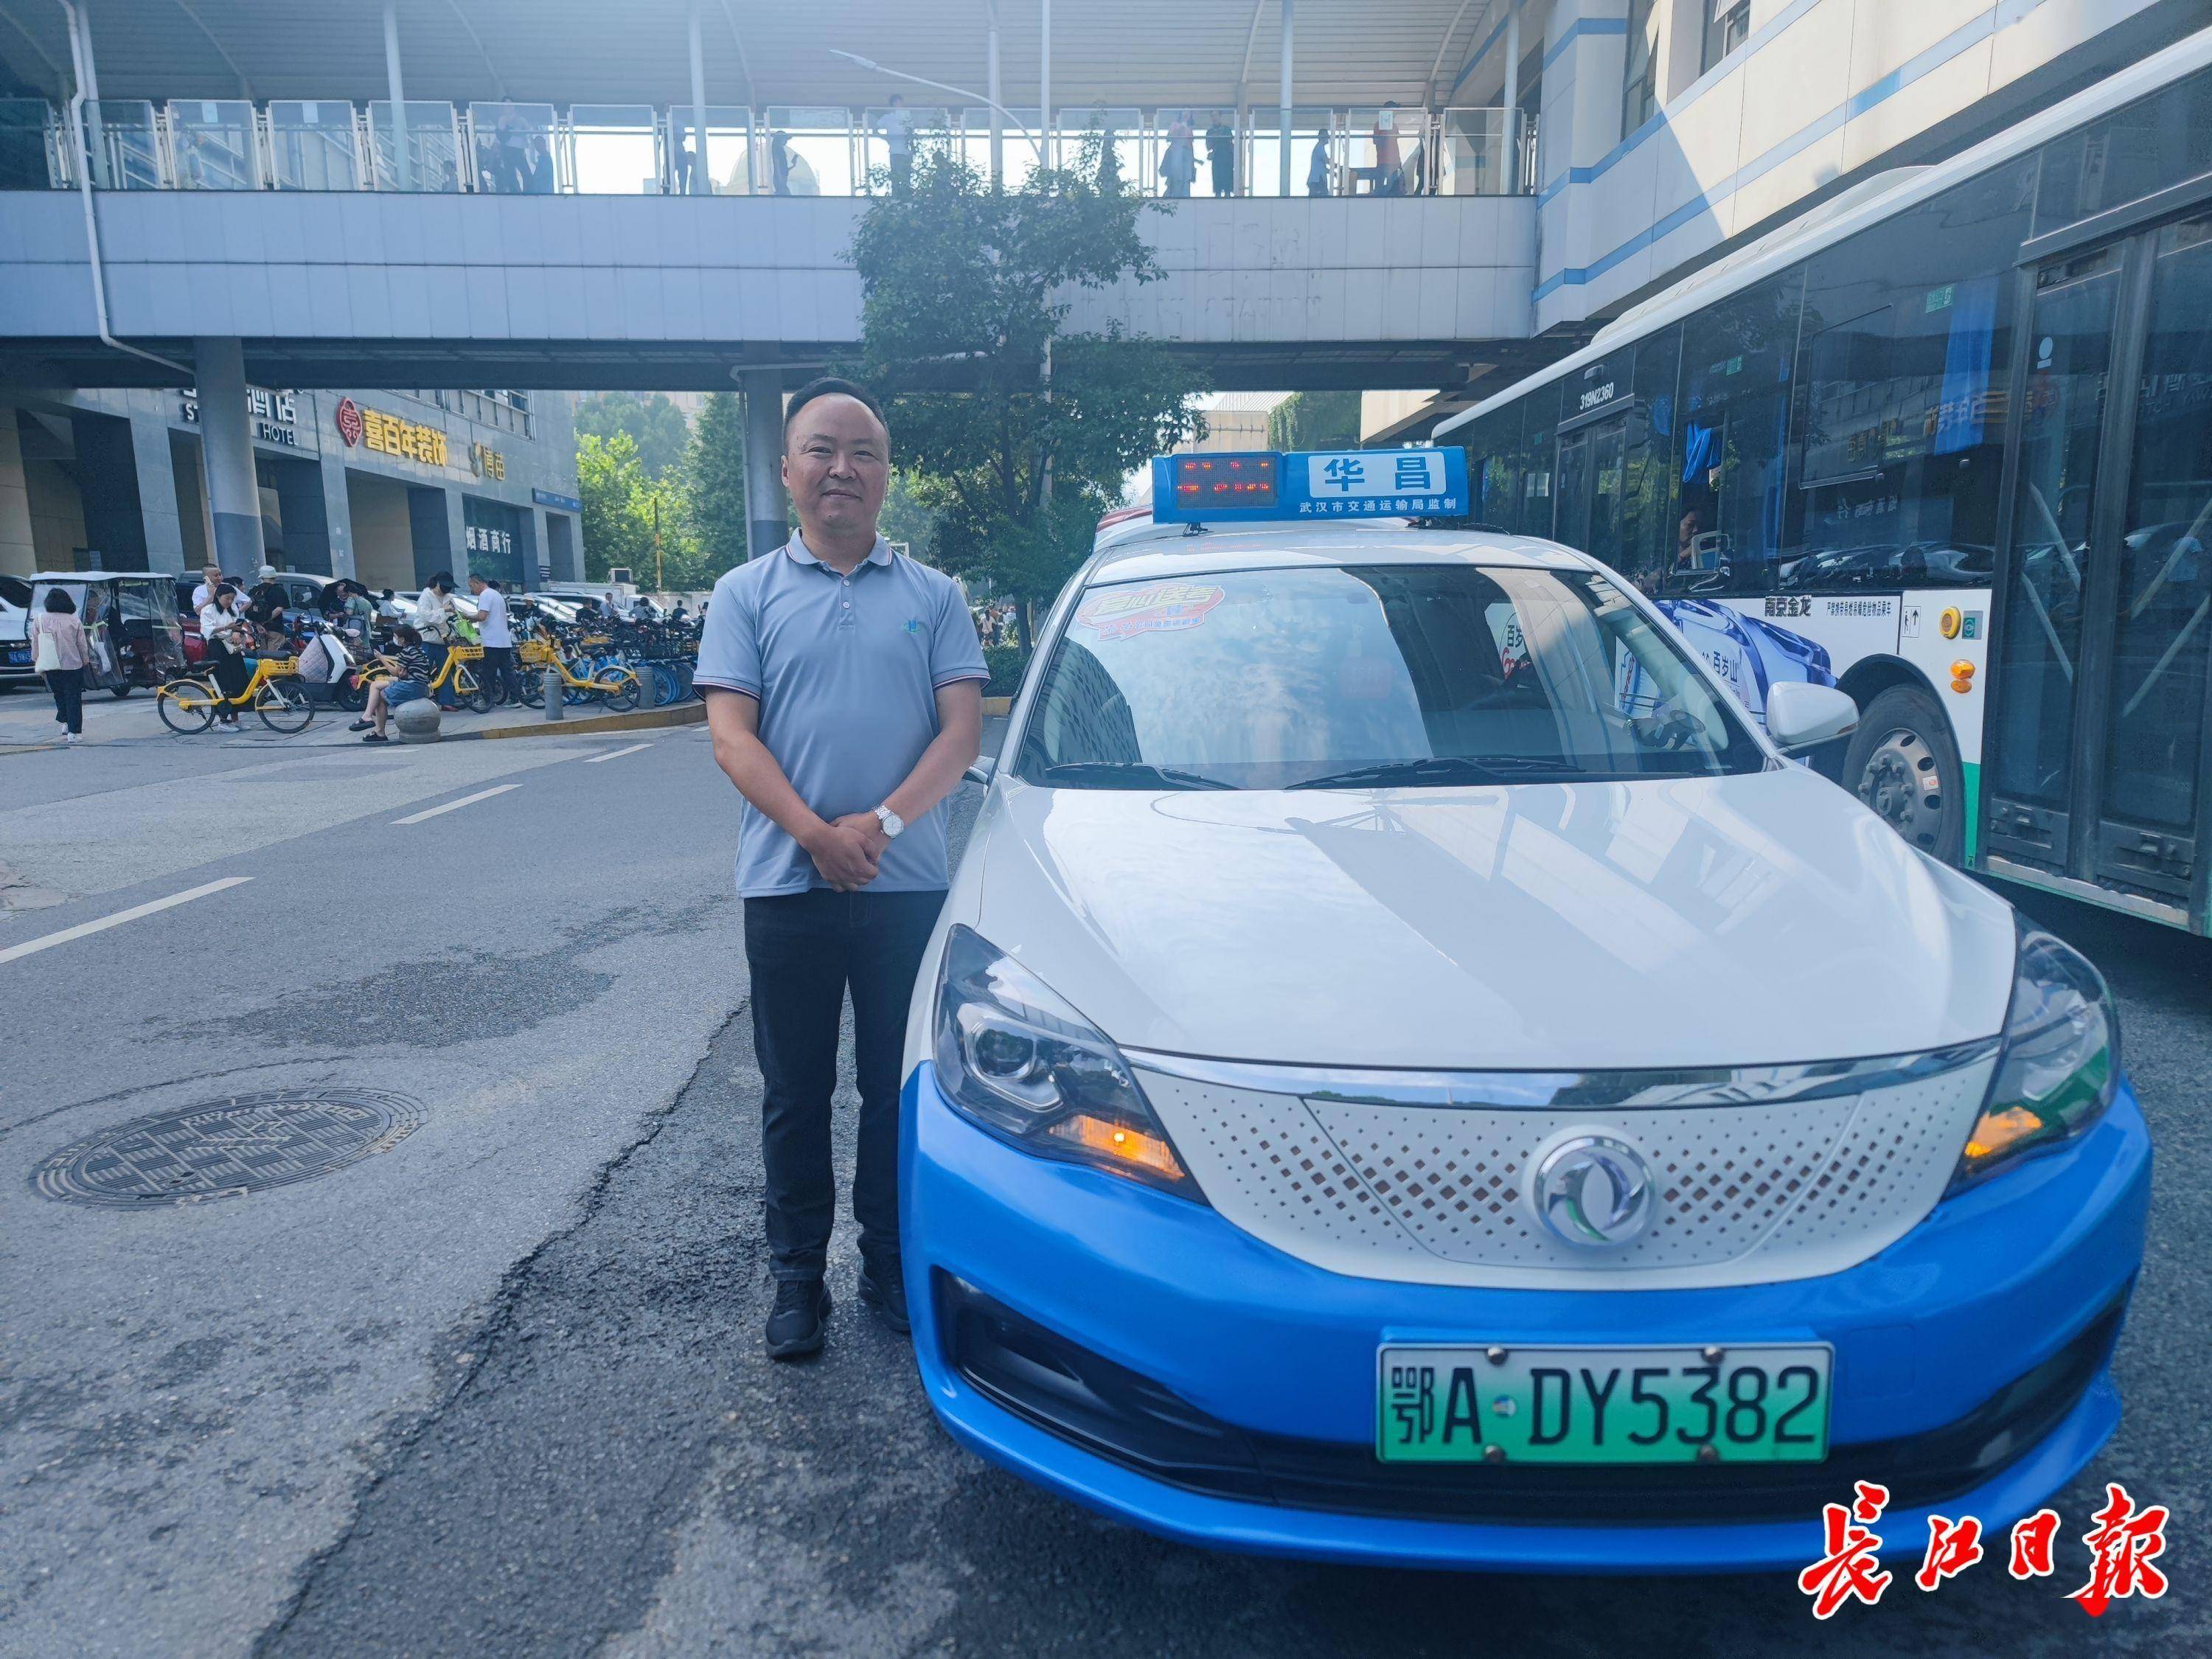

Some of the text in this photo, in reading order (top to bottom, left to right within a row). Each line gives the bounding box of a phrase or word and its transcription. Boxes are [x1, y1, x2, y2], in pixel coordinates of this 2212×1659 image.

[1579, 382, 1614, 410] 319N2360
[263, 422, 299, 445] HOTEL
[362, 408, 448, 467] 喜百年装饰
[1324, 456, 1432, 492] 华昌
[1298, 498, 1458, 514] 武汉市交通运输局监制
[465, 526, 511, 554] 烟酒商行
[1764, 594, 1812, 618] 南京金龙
[1826, 600, 1892, 618] 严禁携带易燃易爆危险物品乘车
[1714, 650, 1738, 683] 百岁山
[1528, 1366, 1820, 1445] DY5382
